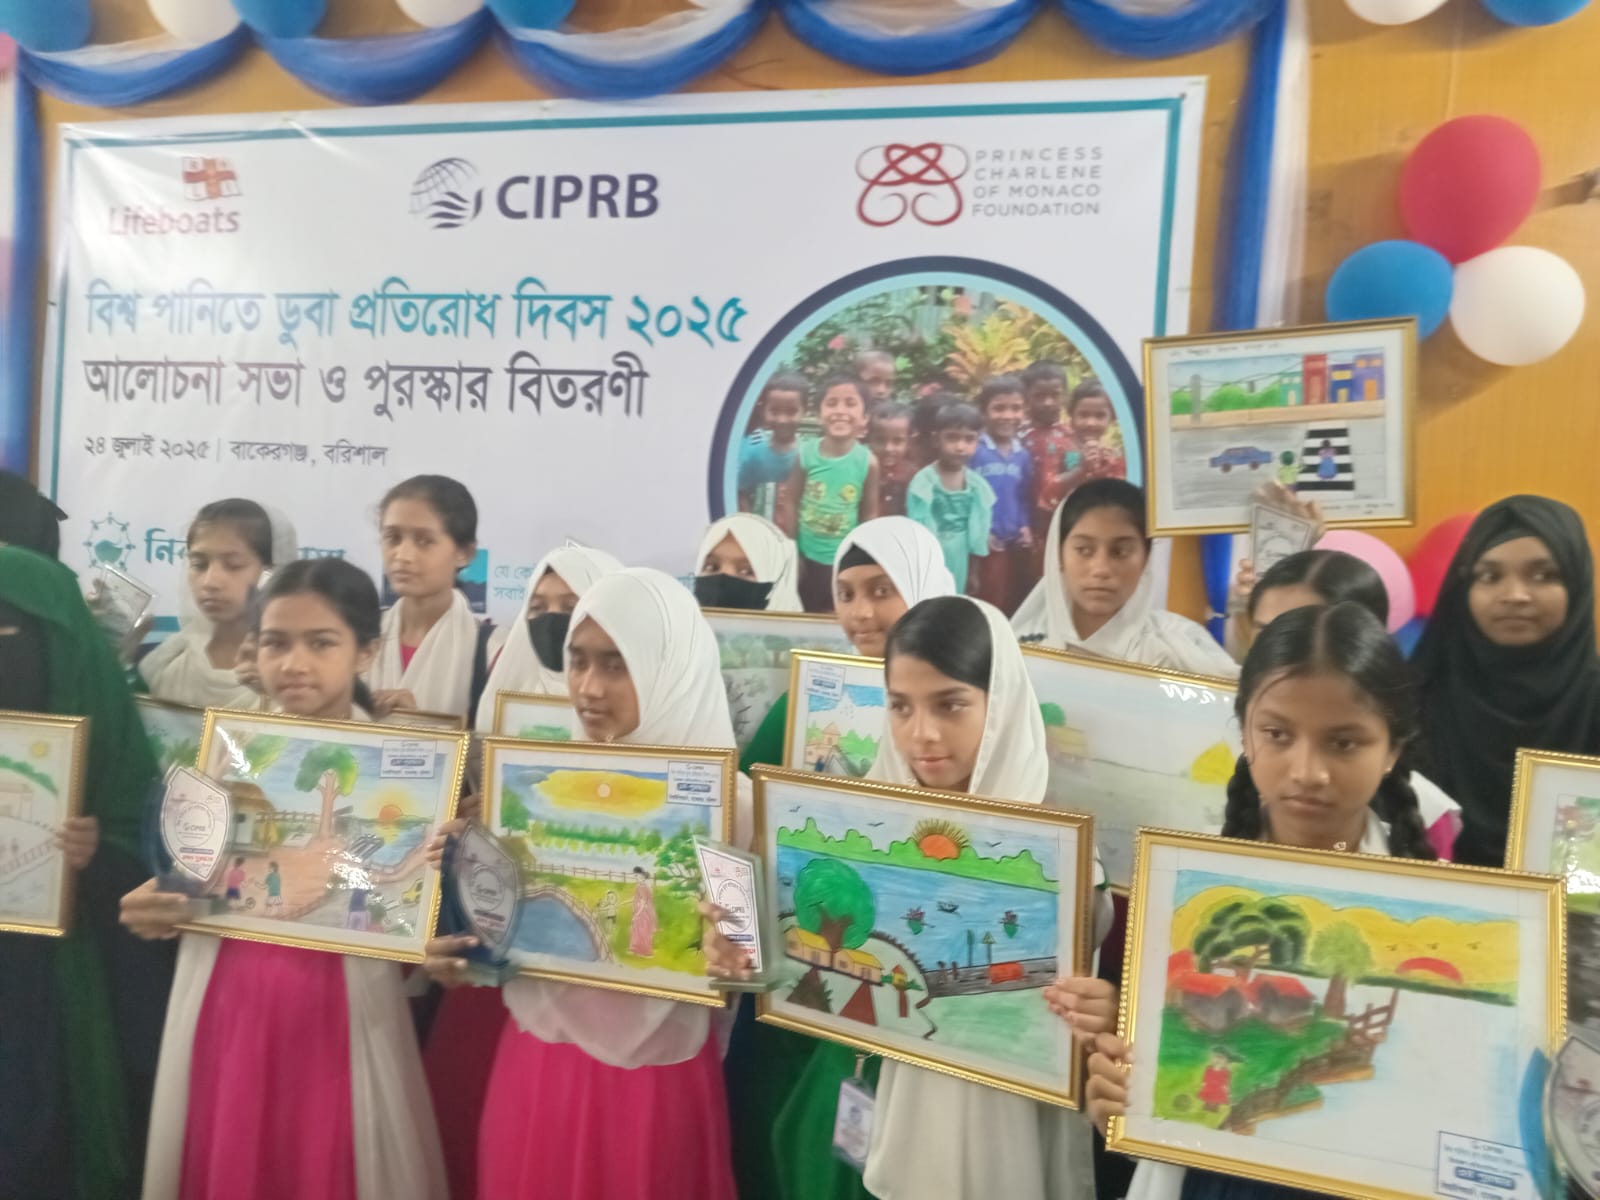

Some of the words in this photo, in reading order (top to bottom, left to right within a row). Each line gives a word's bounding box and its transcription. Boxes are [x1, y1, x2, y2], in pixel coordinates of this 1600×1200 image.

[974, 146, 1103, 163] PRINCESS
[974, 164, 1102, 181] CHARLENE
[497, 172, 661, 220] CIPRB
[973, 184, 1001, 199] OF
[1008, 182, 1101, 198] MONACO
[109, 203, 241, 237] Lifeboats
[971, 202, 1100, 217] FOUNDATION
[87, 279, 140, 337] বিশ্ব
[150, 279, 263, 337] পানিতে
[276, 290, 338, 348] ডুবা
[348, 277, 500, 338] প্রতিরোধ
[514, 277, 612, 342] দিবস
[626, 295, 748, 347] ২০২৫
[83, 355, 224, 405] আলোচনা
[236, 357, 304, 406] সভা
[320, 363, 347, 404] ও
[363, 359, 492, 420] পুরস্কার
[506, 350, 650, 418] বিতরণী
[84, 436, 106, 456] ২৪
[111, 434, 155, 459] জুলাই
[159, 439, 211, 460] ২০২৫
[322, 439, 388, 466] বরিশাল
